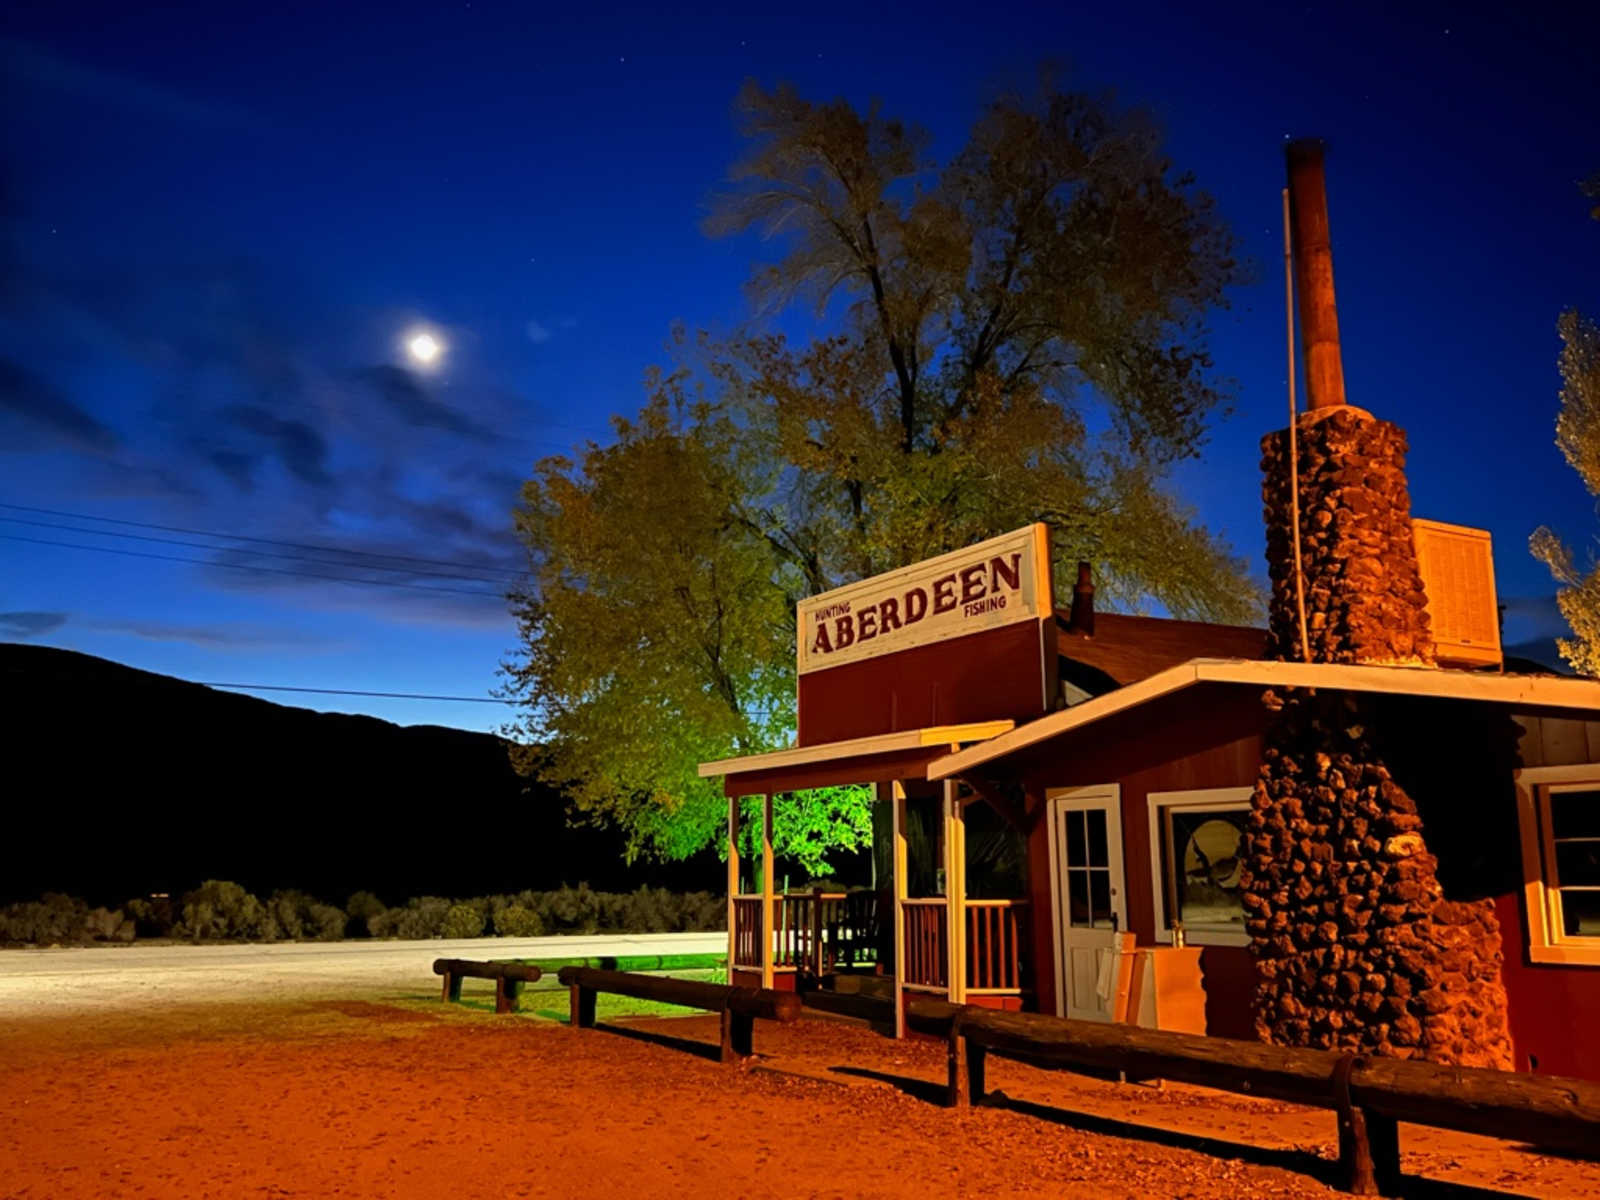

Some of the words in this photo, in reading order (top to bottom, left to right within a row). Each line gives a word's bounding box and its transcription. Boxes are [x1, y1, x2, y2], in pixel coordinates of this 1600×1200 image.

[812, 553, 1021, 654] ABERDEEN
[815, 601, 851, 622] HUNTING
[964, 595, 1006, 618] FISHING
